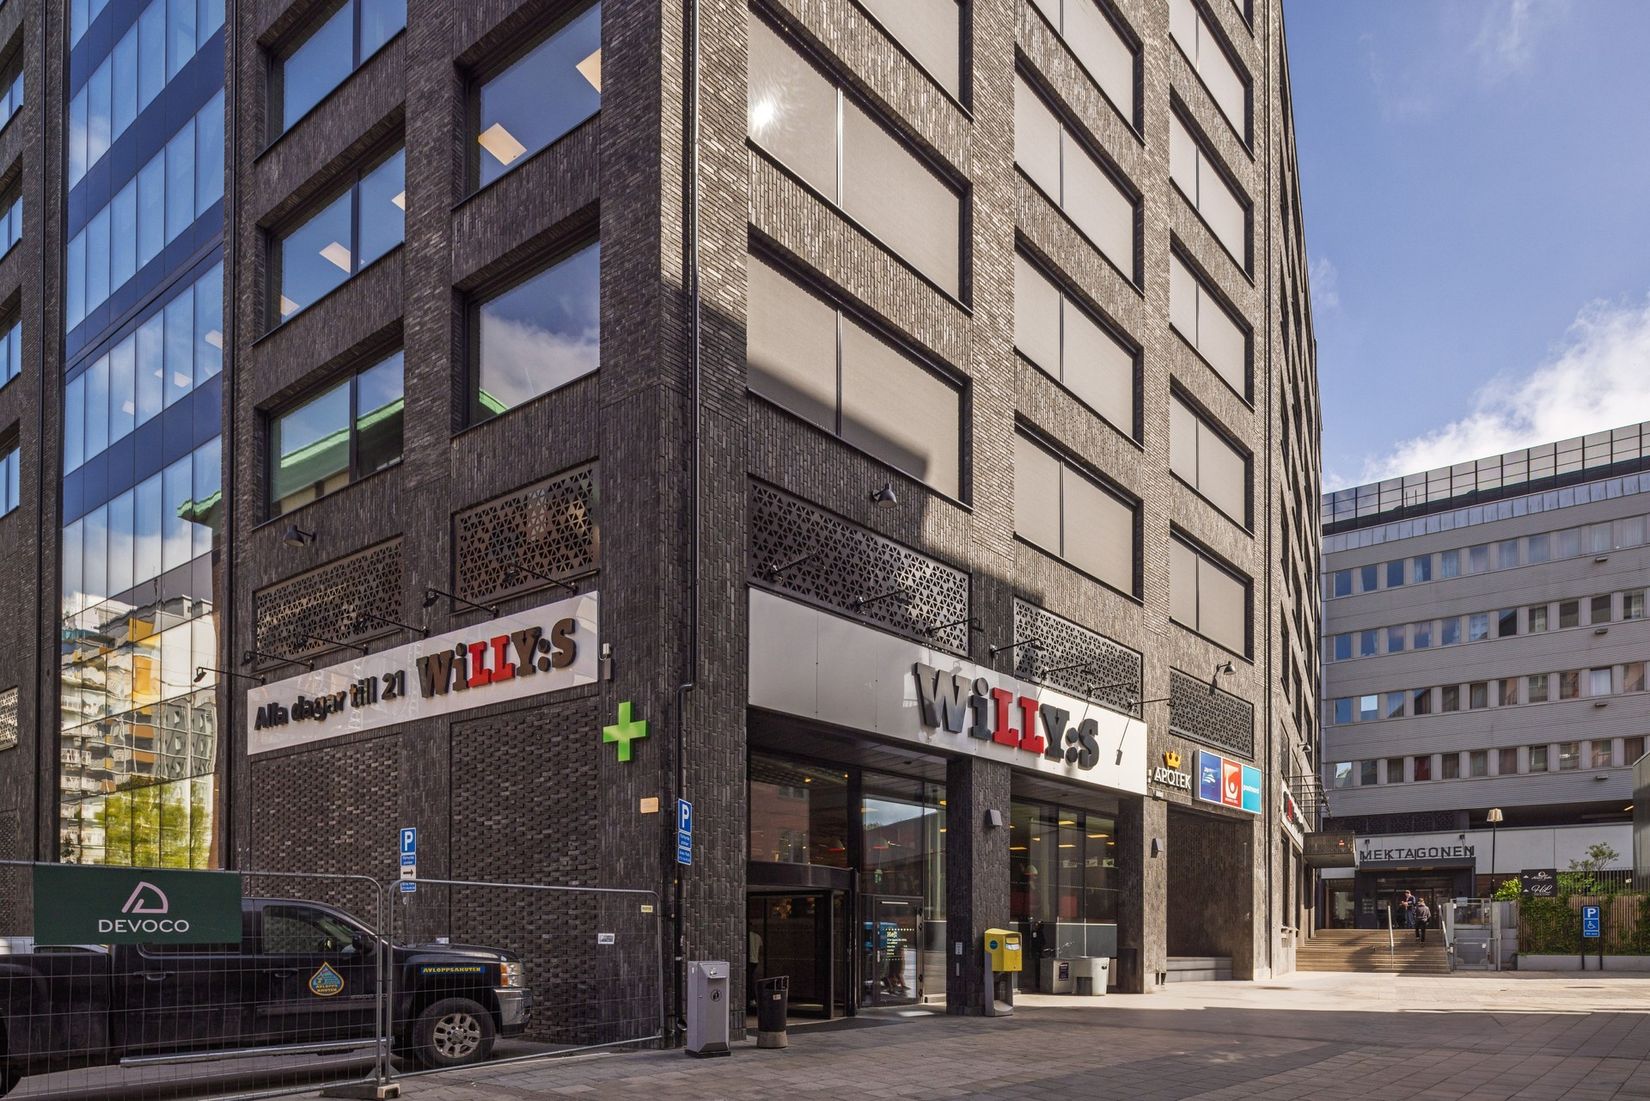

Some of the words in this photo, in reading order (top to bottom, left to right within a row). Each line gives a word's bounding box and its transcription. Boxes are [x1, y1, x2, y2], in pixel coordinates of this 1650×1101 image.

[254, 702, 289, 730] Alla
[291, 691, 347, 722] dagar
[349, 676, 377, 708] till
[381, 669, 405, 700] 21
[1153, 766, 1192, 790] APOTEK
[681, 803, 690, 829] P
[404, 830, 414, 852] P
[1360, 845, 1475, 862] MEKTAGONEN
[1587, 908, 1597, 918] P
[98, 919, 190, 933] DEVOCO
